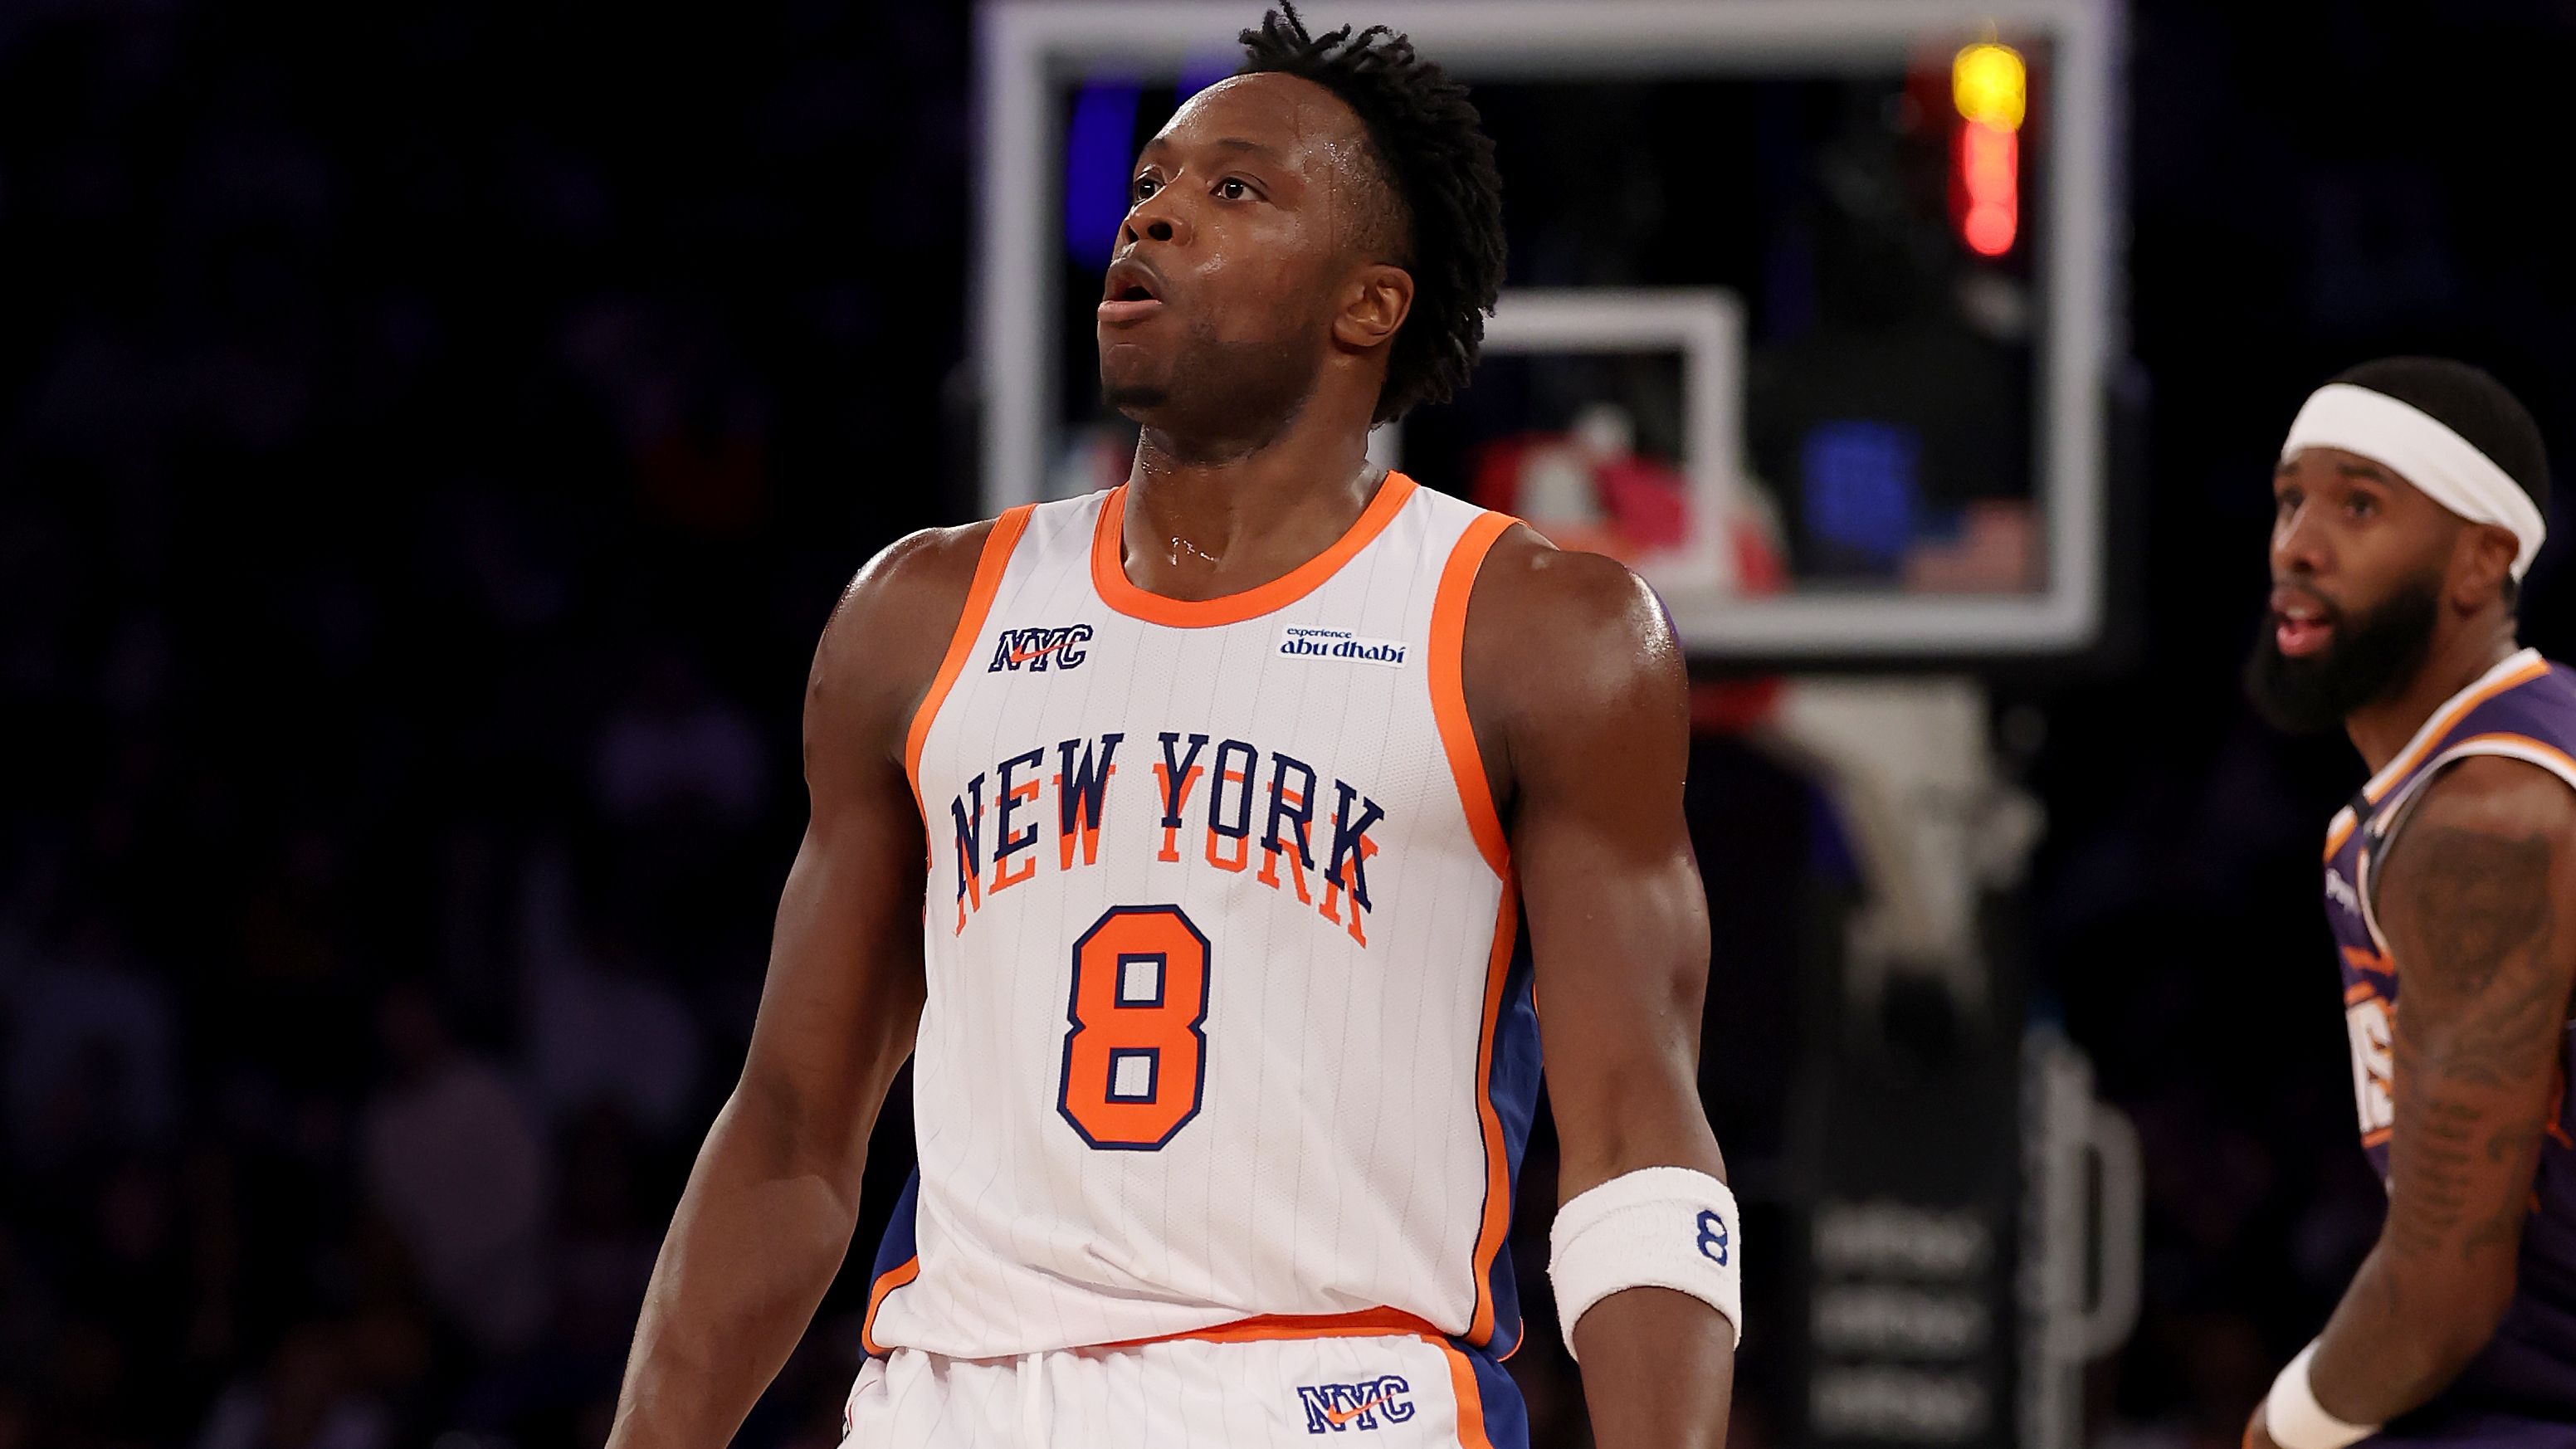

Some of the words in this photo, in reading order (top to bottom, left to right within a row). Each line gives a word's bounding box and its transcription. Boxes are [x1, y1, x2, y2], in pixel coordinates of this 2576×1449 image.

[988, 624, 1094, 672] NYC
[1280, 637, 1329, 656] abu
[1332, 641, 1406, 663] dhabi
[1286, 627, 1352, 639] experience
[952, 733, 1124, 938] NEW
[1153, 732, 1384, 949] YORK
[1056, 904, 1211, 1151] 8
[1696, 1209, 1727, 1266] 8
[1297, 1375, 1415, 1434] NYC
